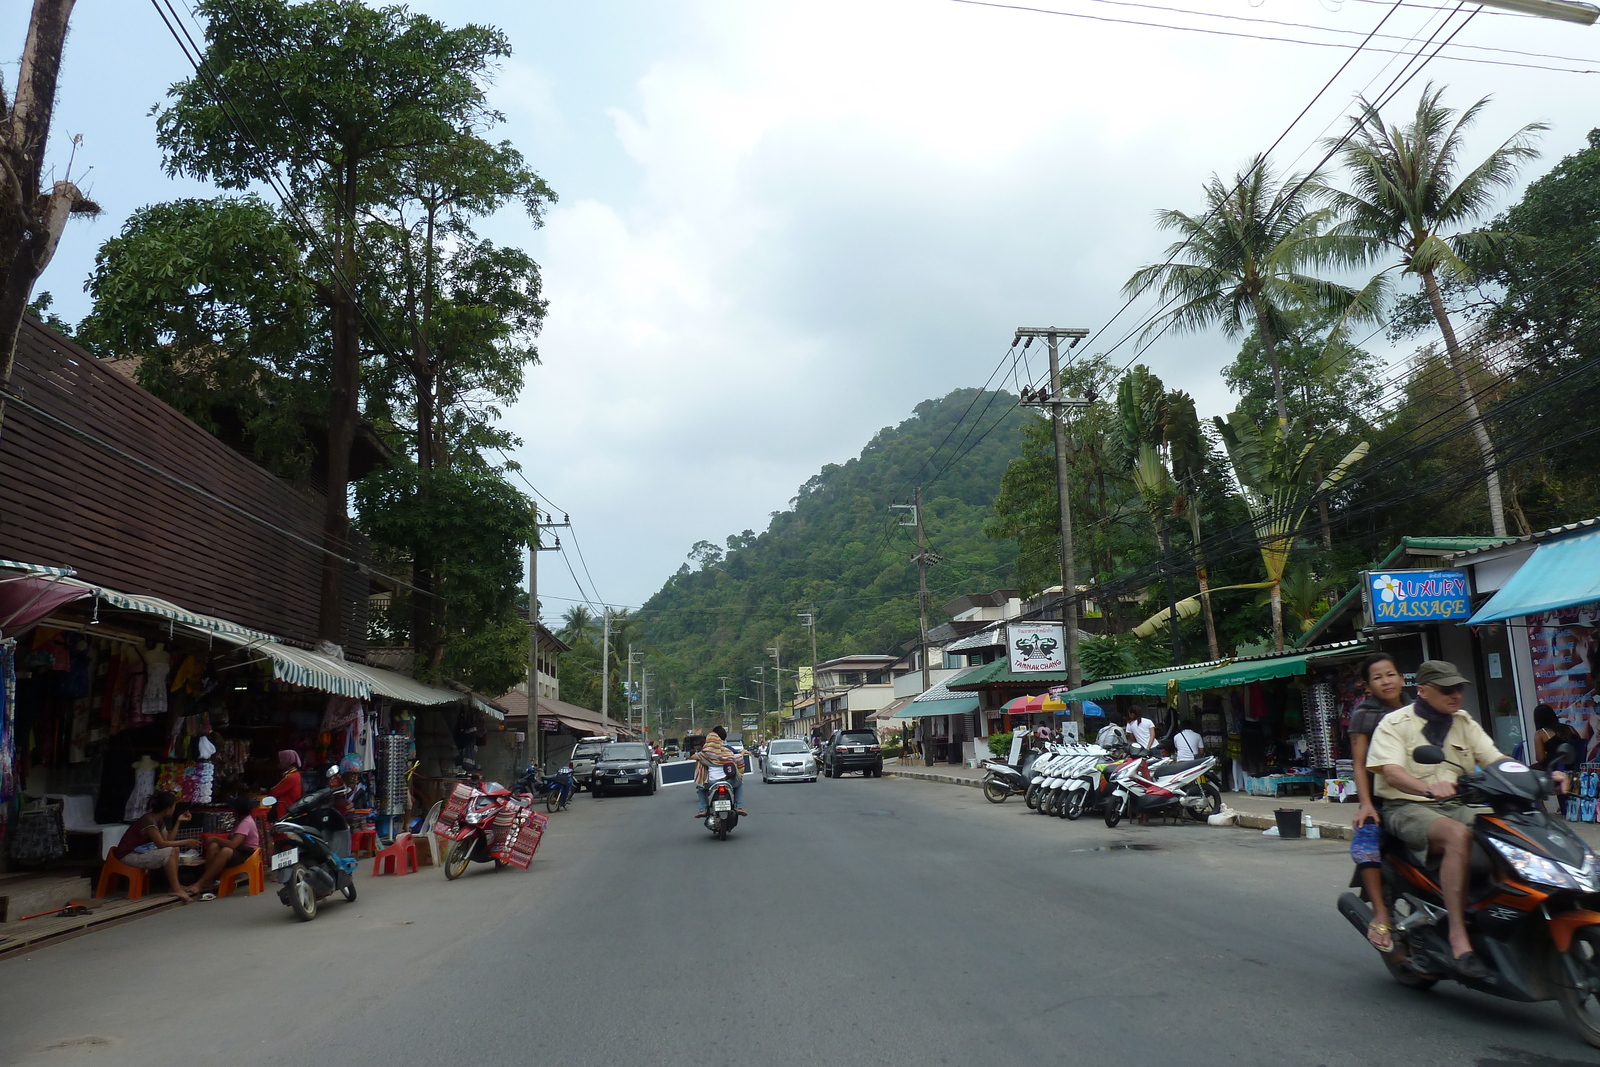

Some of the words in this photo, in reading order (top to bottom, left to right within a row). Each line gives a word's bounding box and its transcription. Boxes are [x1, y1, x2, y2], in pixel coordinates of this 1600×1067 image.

[1397, 579, 1465, 597] LUXURY
[1378, 600, 1466, 618] MASSAGE
[1015, 660, 1040, 671] TAMNAK
[1040, 659, 1061, 670] CHANG
[727, 765, 732, 773] 3
